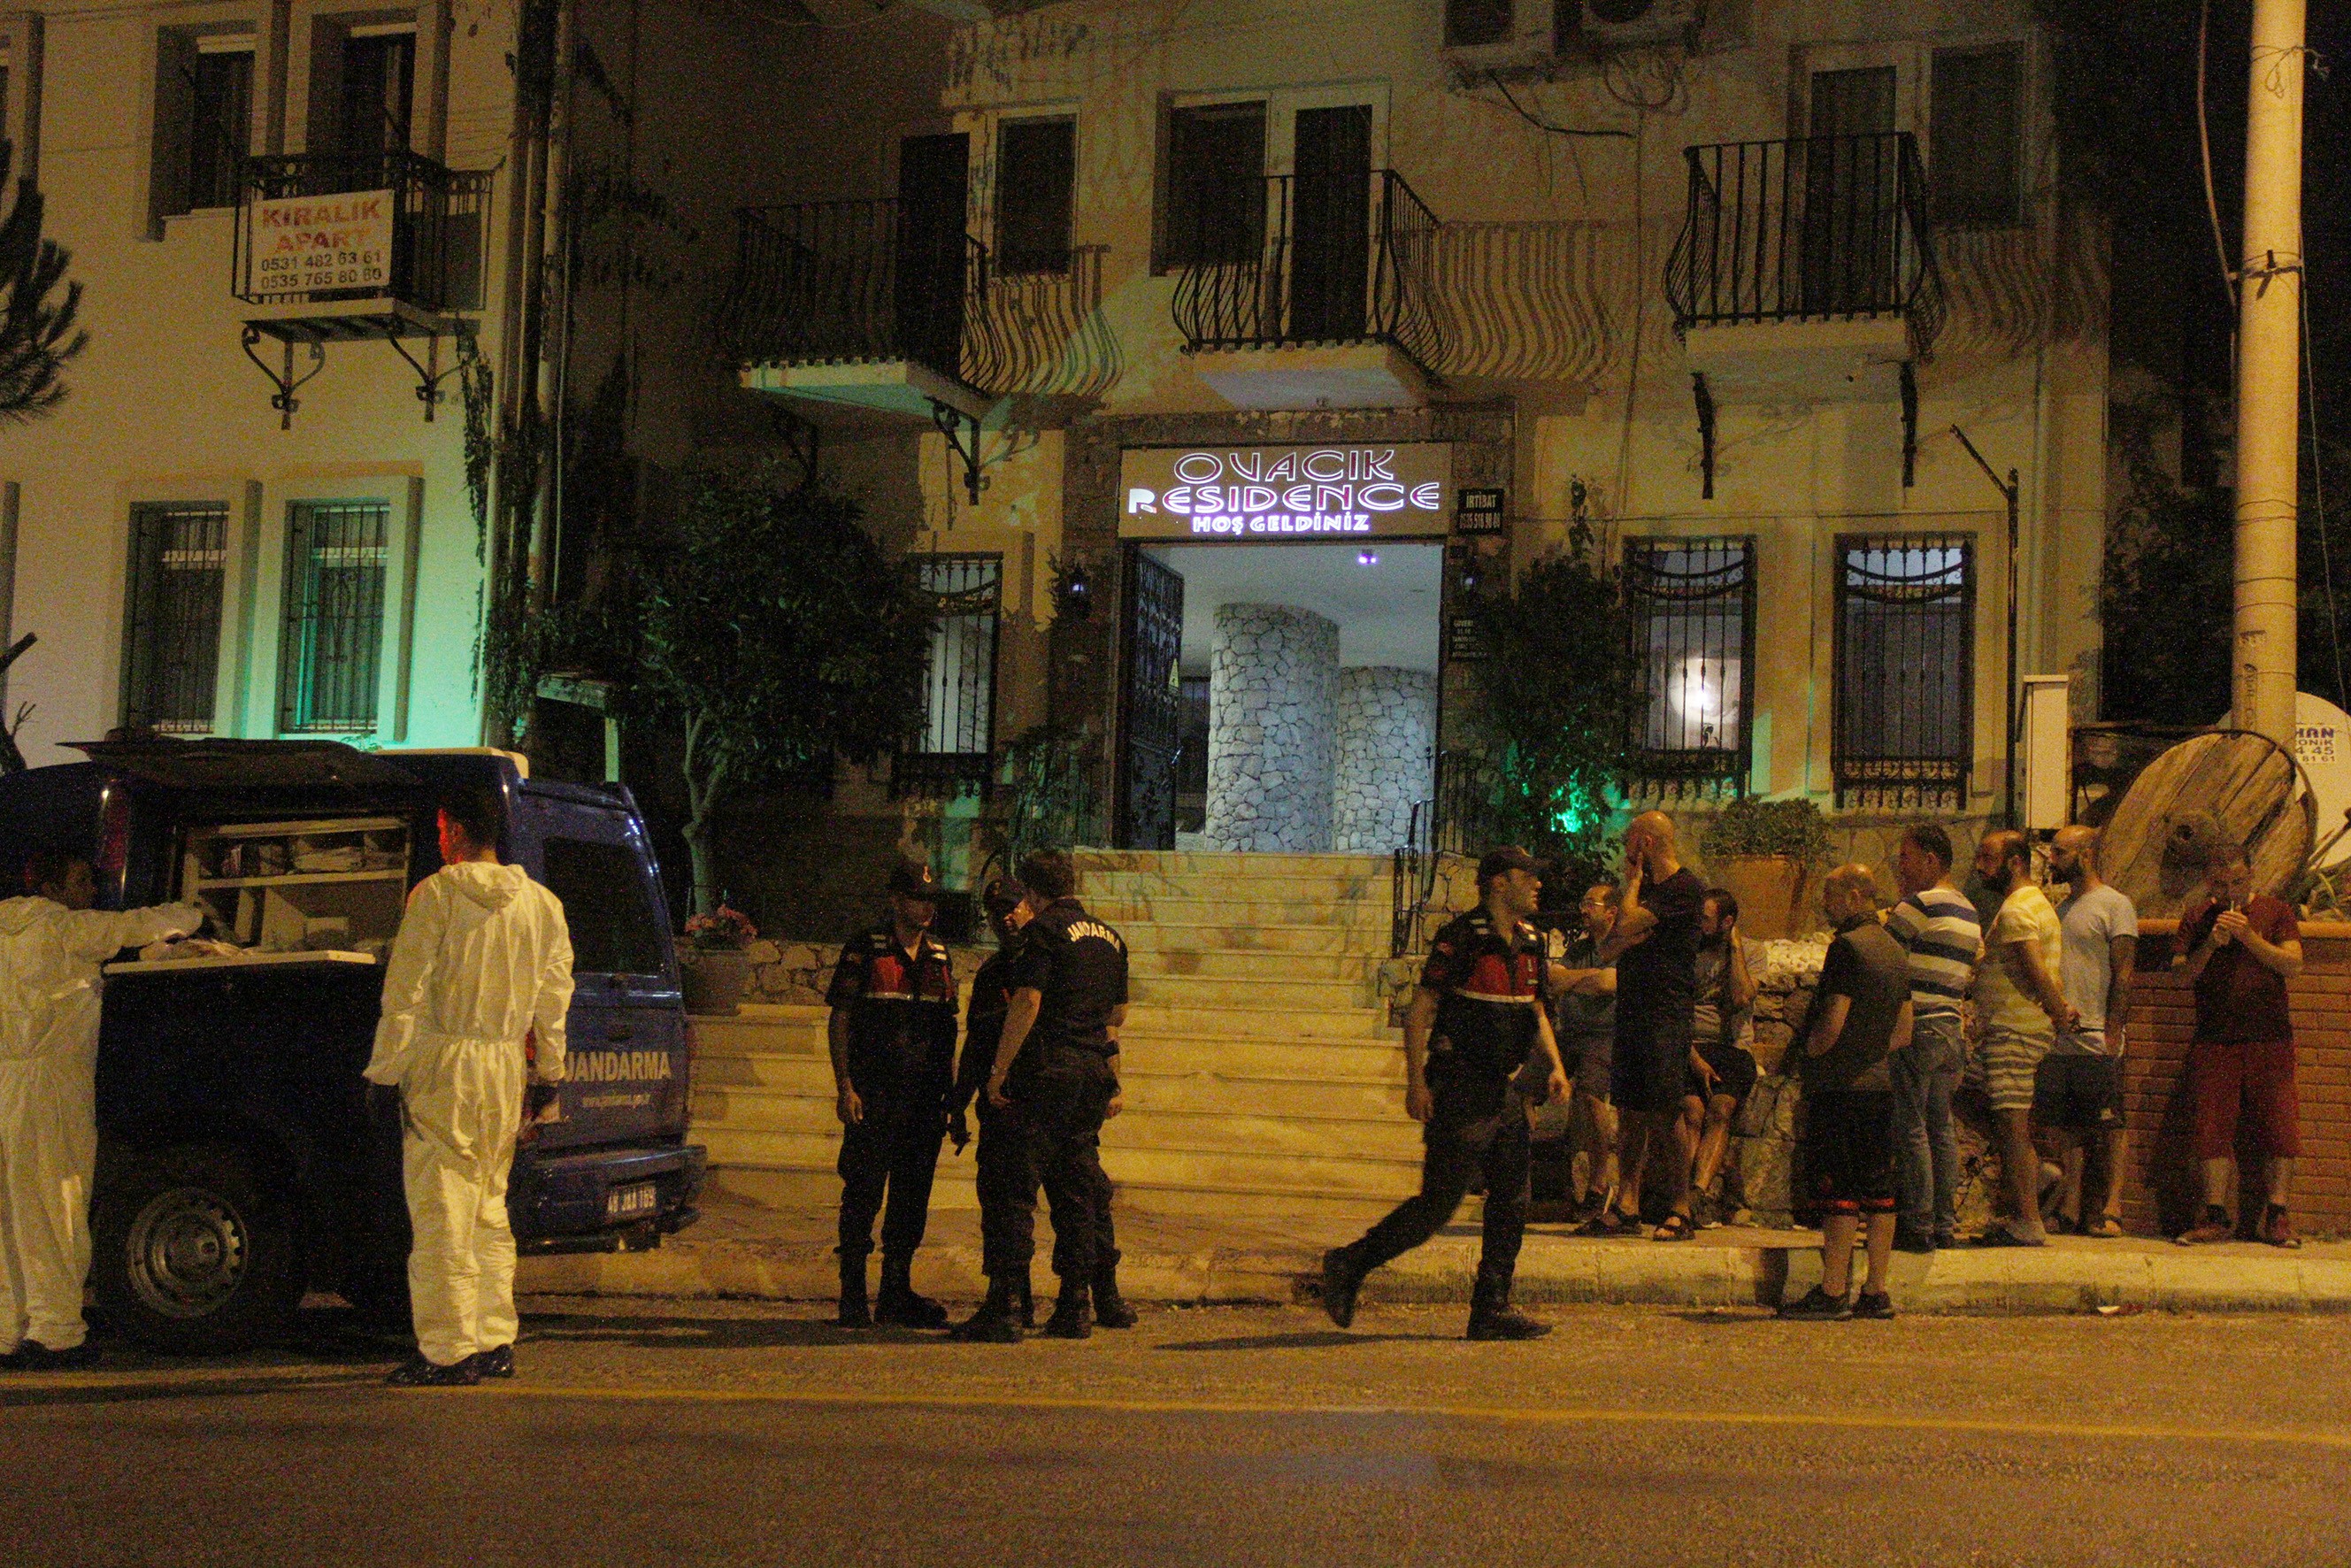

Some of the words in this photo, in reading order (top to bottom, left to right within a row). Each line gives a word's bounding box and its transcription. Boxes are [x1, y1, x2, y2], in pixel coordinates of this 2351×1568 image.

[263, 200, 381, 227] KIRALIK
[276, 228, 372, 251] APART
[261, 257, 298, 272] 0531
[363, 250, 381, 264] 61
[260, 273, 298, 289] 0535
[303, 271, 334, 286] 765
[338, 270, 358, 283] 80
[1173, 449, 1394, 484] OVACIK
[1128, 482, 1441, 514] RESIDENCE
[1192, 514, 1244, 535] HOŞ
[1249, 511, 1370, 532] GELDİNİZ
[1066, 920, 1121, 953] JANDARMA
[564, 1050, 672, 1082] JANDARMA
